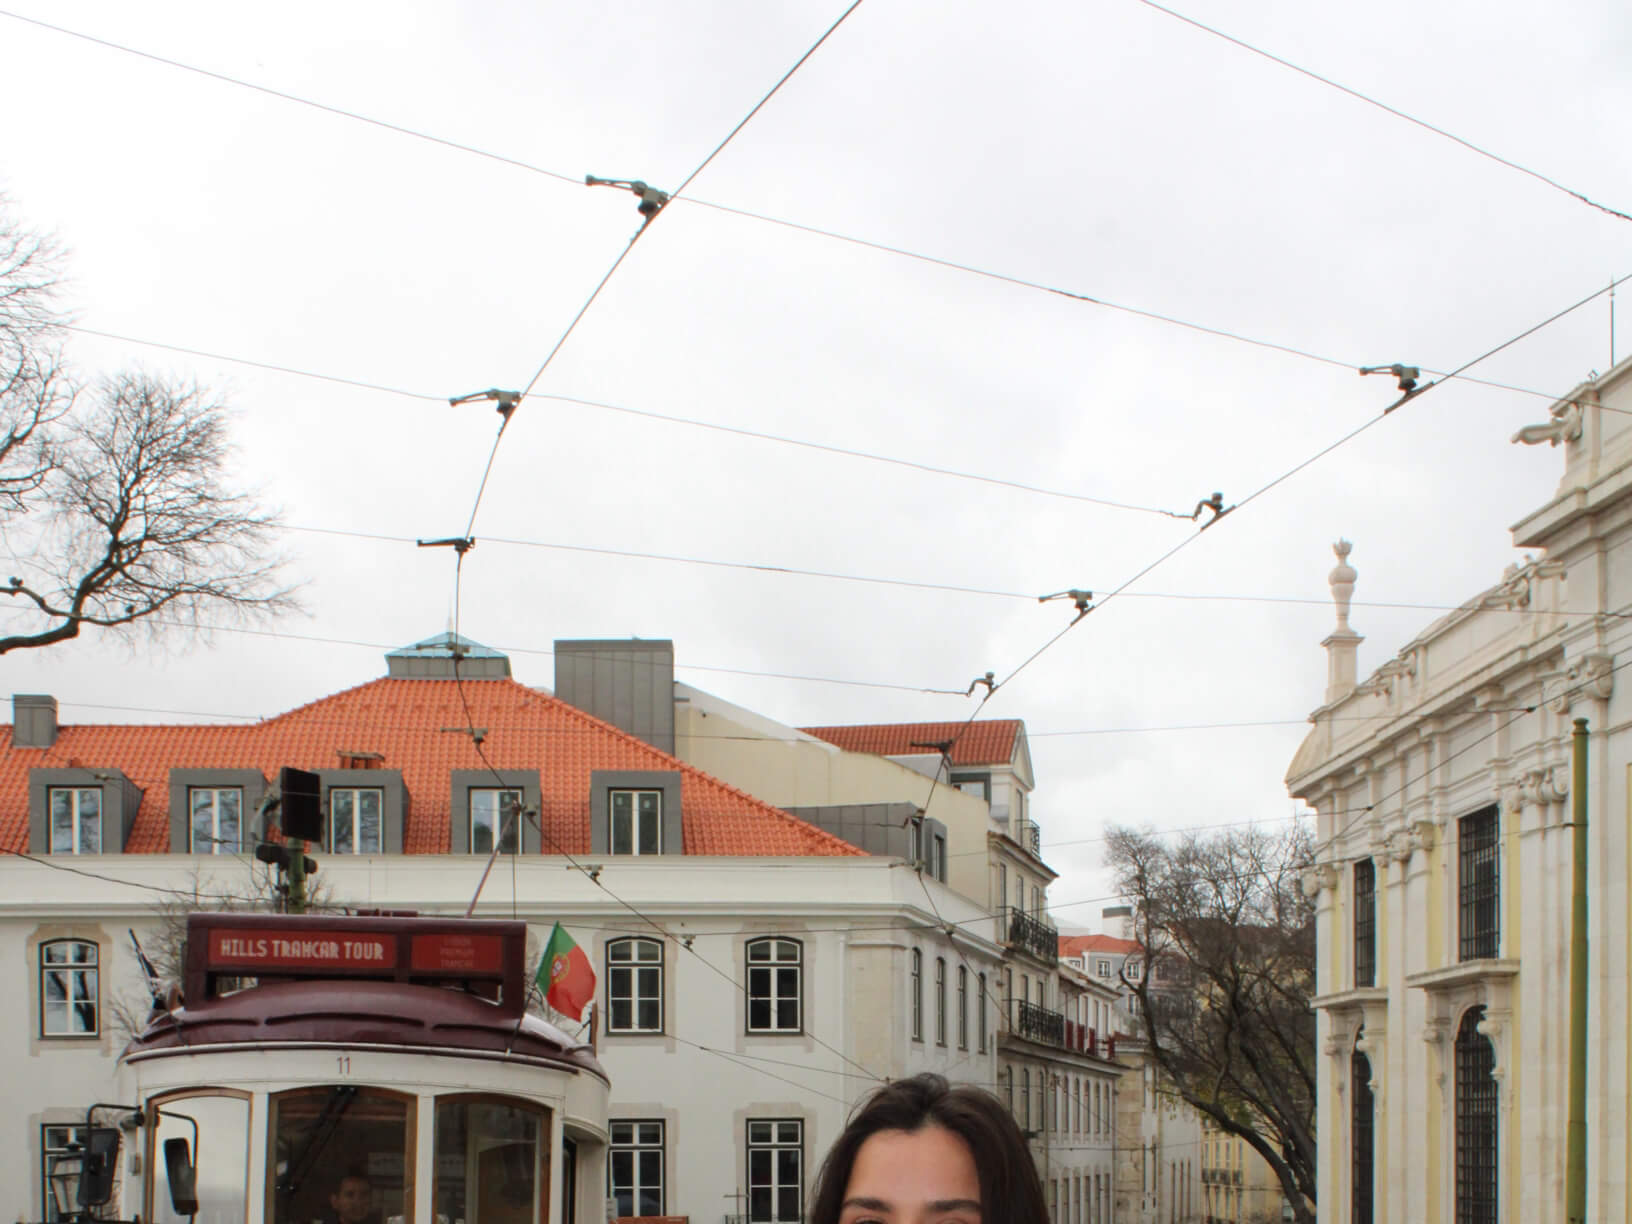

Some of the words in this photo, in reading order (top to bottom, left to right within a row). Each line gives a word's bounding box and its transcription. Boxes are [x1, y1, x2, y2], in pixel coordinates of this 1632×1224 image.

[220, 939, 268, 958] HILLS
[271, 940, 339, 959] TRAMCAR
[343, 942, 384, 960] TOUR
[336, 1055, 351, 1075] 11
